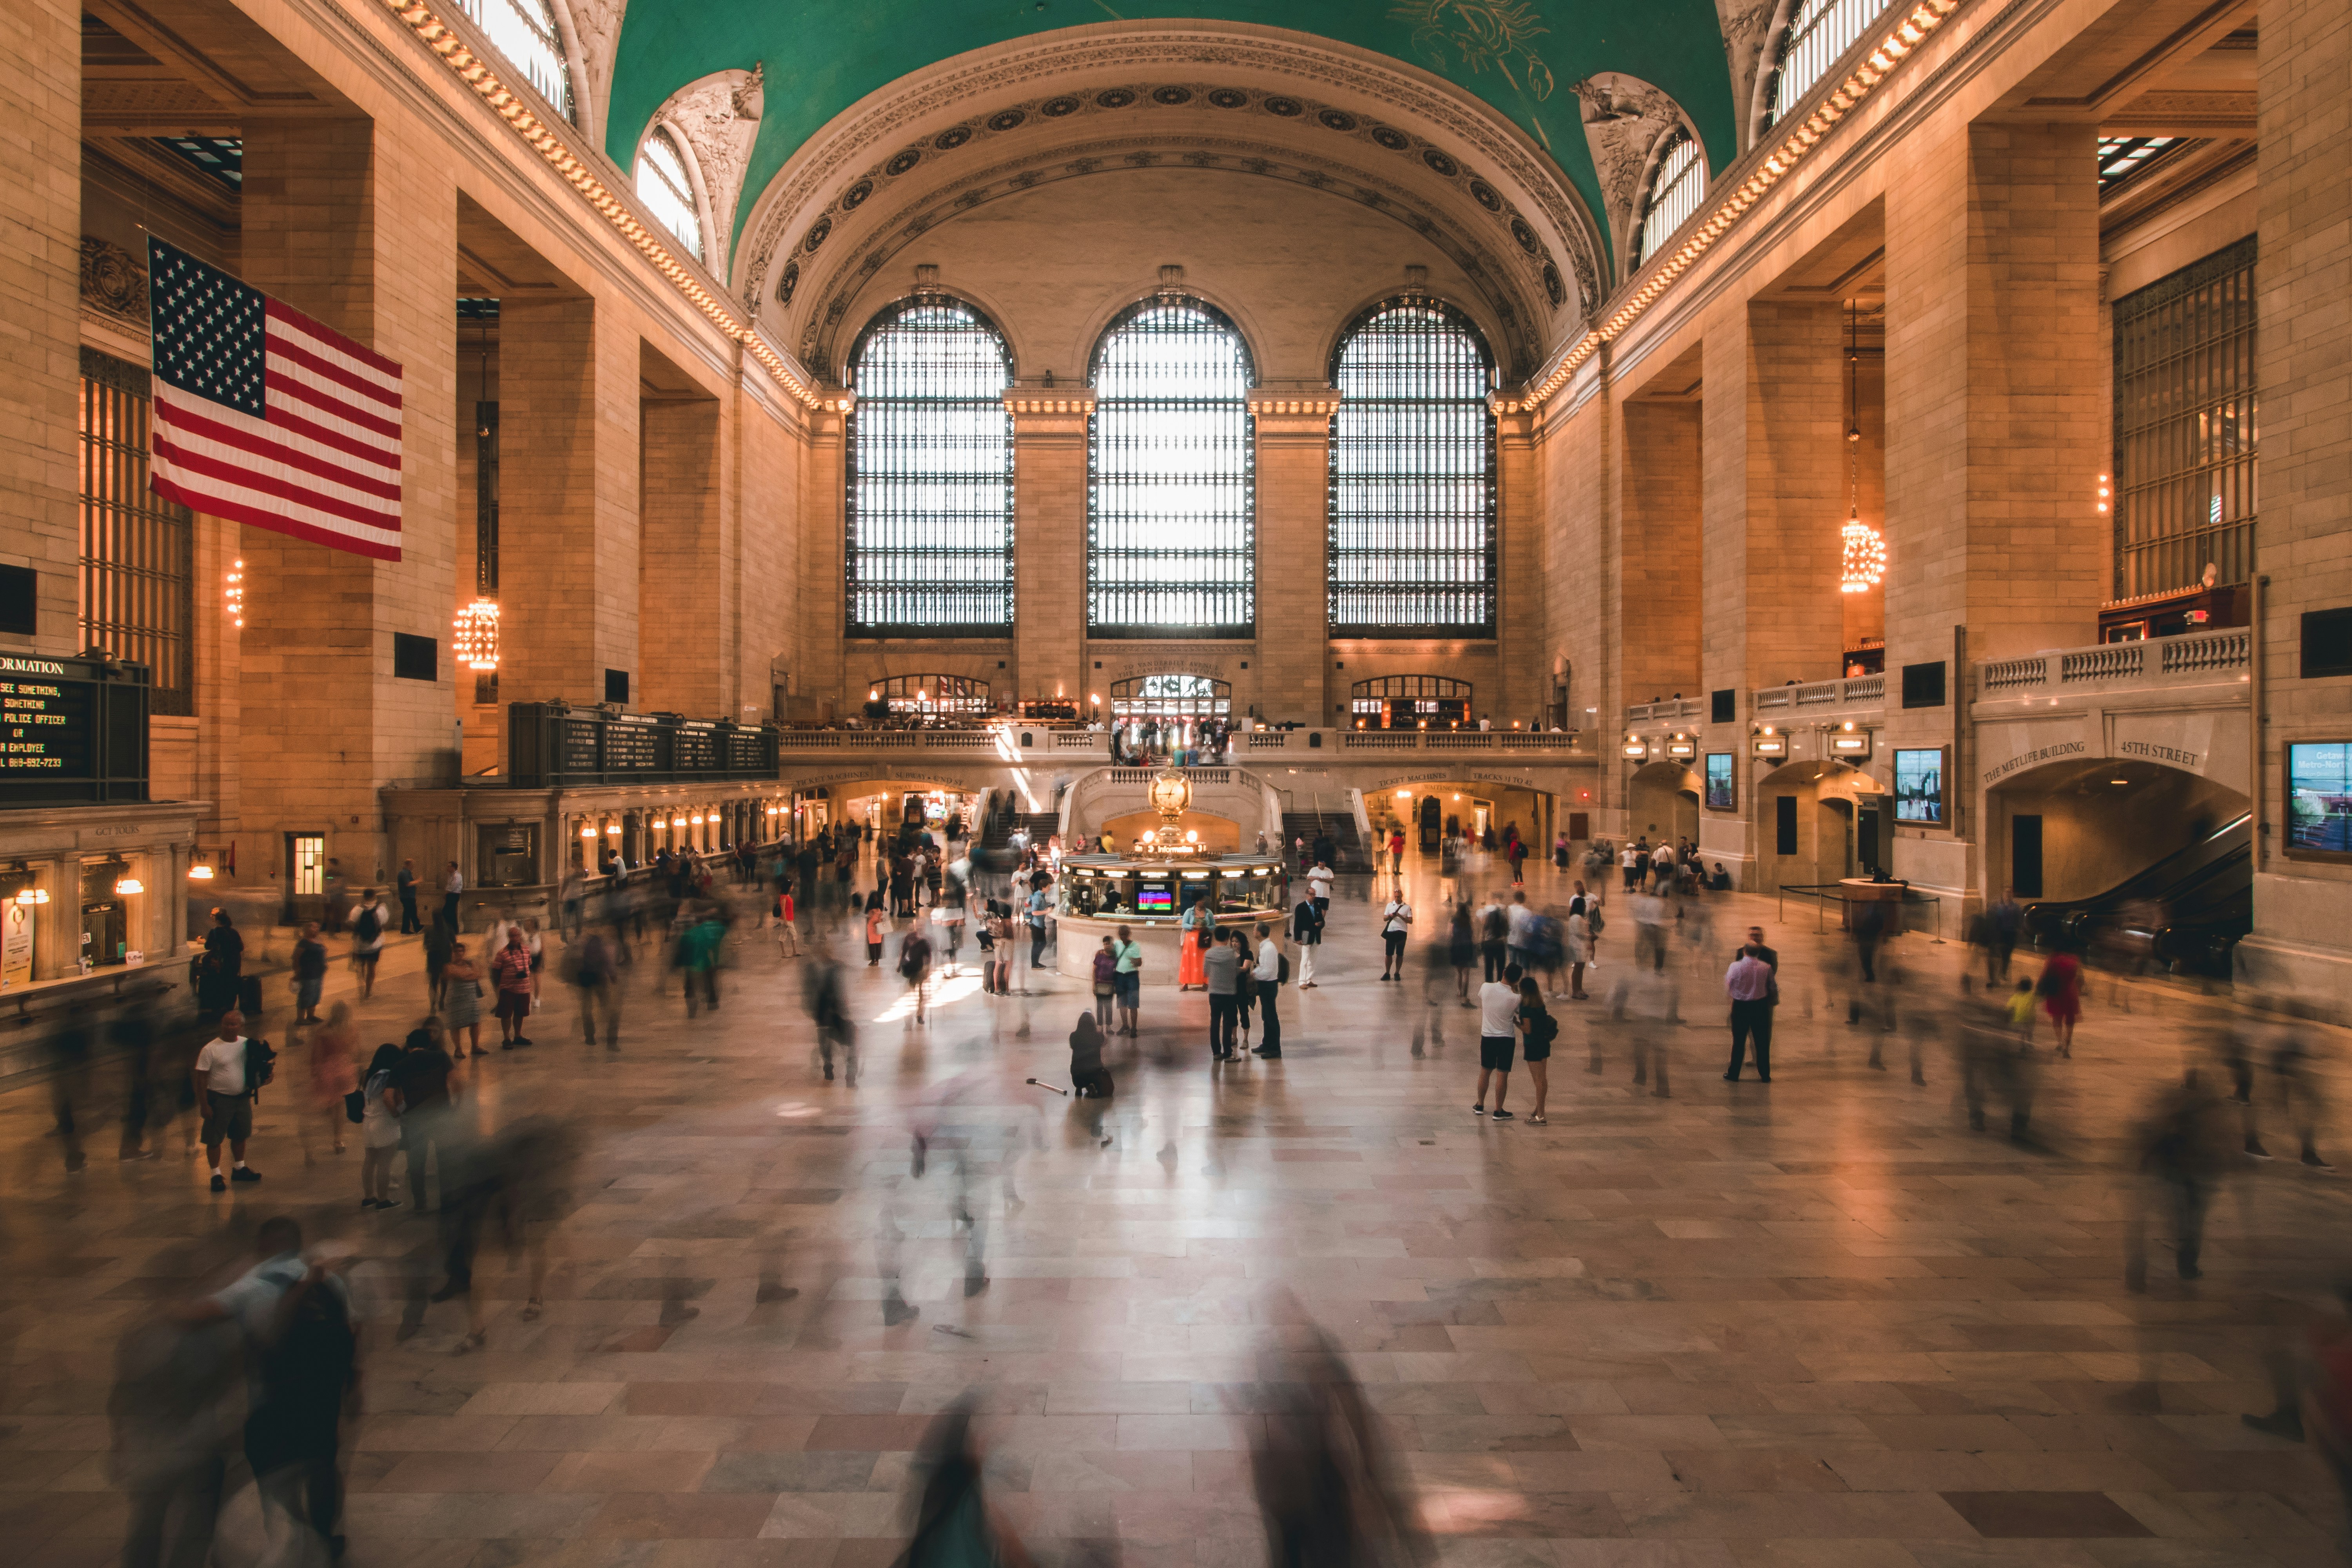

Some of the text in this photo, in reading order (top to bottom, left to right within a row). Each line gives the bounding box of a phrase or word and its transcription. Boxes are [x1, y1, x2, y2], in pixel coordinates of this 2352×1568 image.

[0, 683, 60, 697] SEE SOMETHING,
[4, 698, 45, 710] SOMETHING
[4, 713, 66, 724] POLICE OFFICER
[13, 729, 24, 738] OR
[9, 743, 45, 753] EMPLOYEE
[2121, 741, 2198, 766] 45TH STREET
[1983, 741, 2085, 783] THE METLIFE BUILDING
[796, 771, 869, 786] TICKET MACHINES
[895, 771, 926, 780] SUBWAY
[1378, 772, 1446, 787] TICKET MACHINES
[1473, 773, 1502, 781] TRACKS
[1158, 845, 1194, 853] Information
